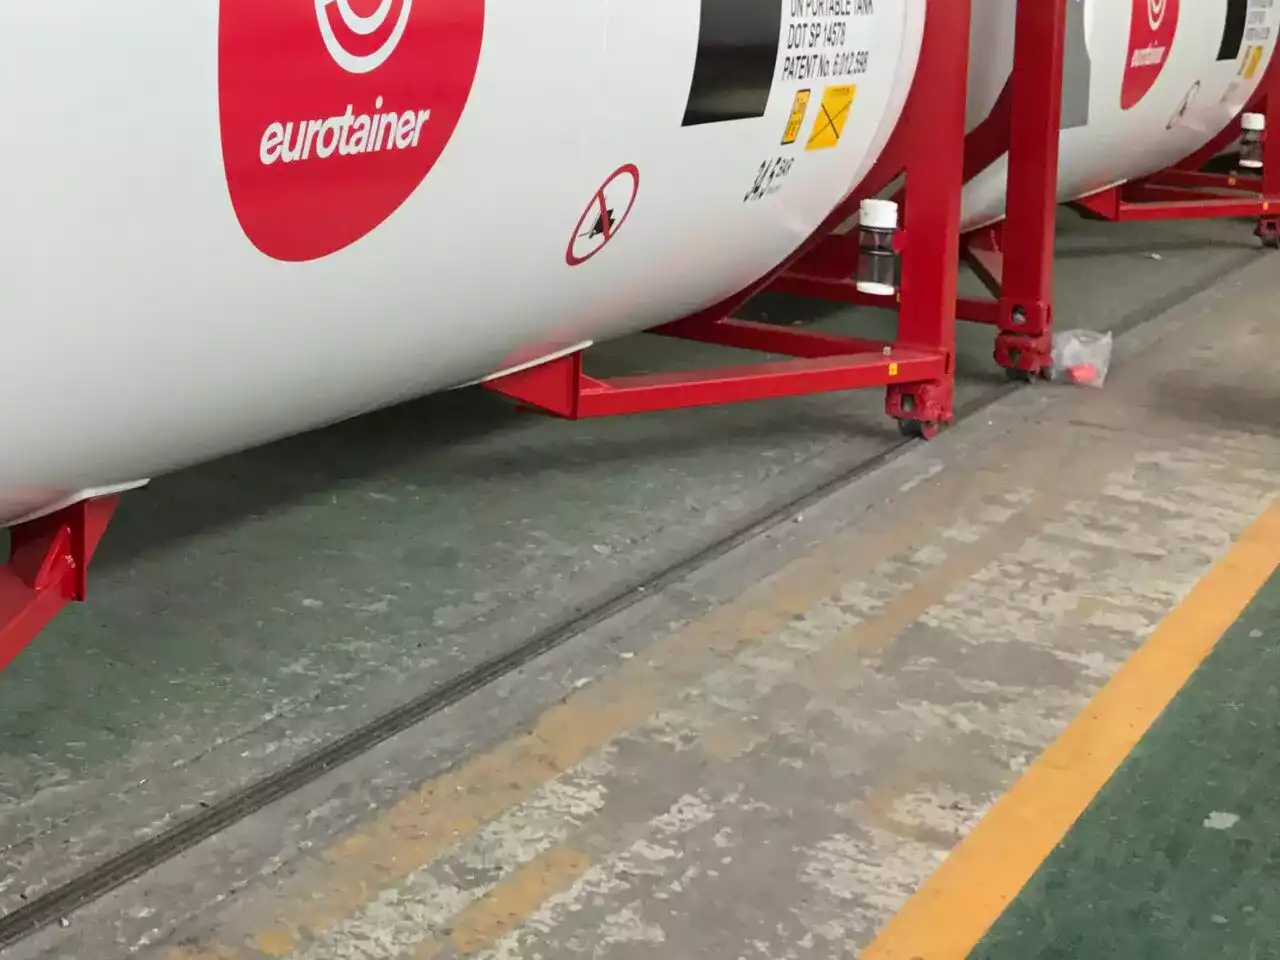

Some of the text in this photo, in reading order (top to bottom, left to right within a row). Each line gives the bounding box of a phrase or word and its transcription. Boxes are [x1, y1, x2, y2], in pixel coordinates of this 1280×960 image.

[787, 23, 808, 49] DOT
[809, 22, 821, 48] SP
[781, 54, 818, 81] PATENT
[259, 96, 431, 165] eurotainer
